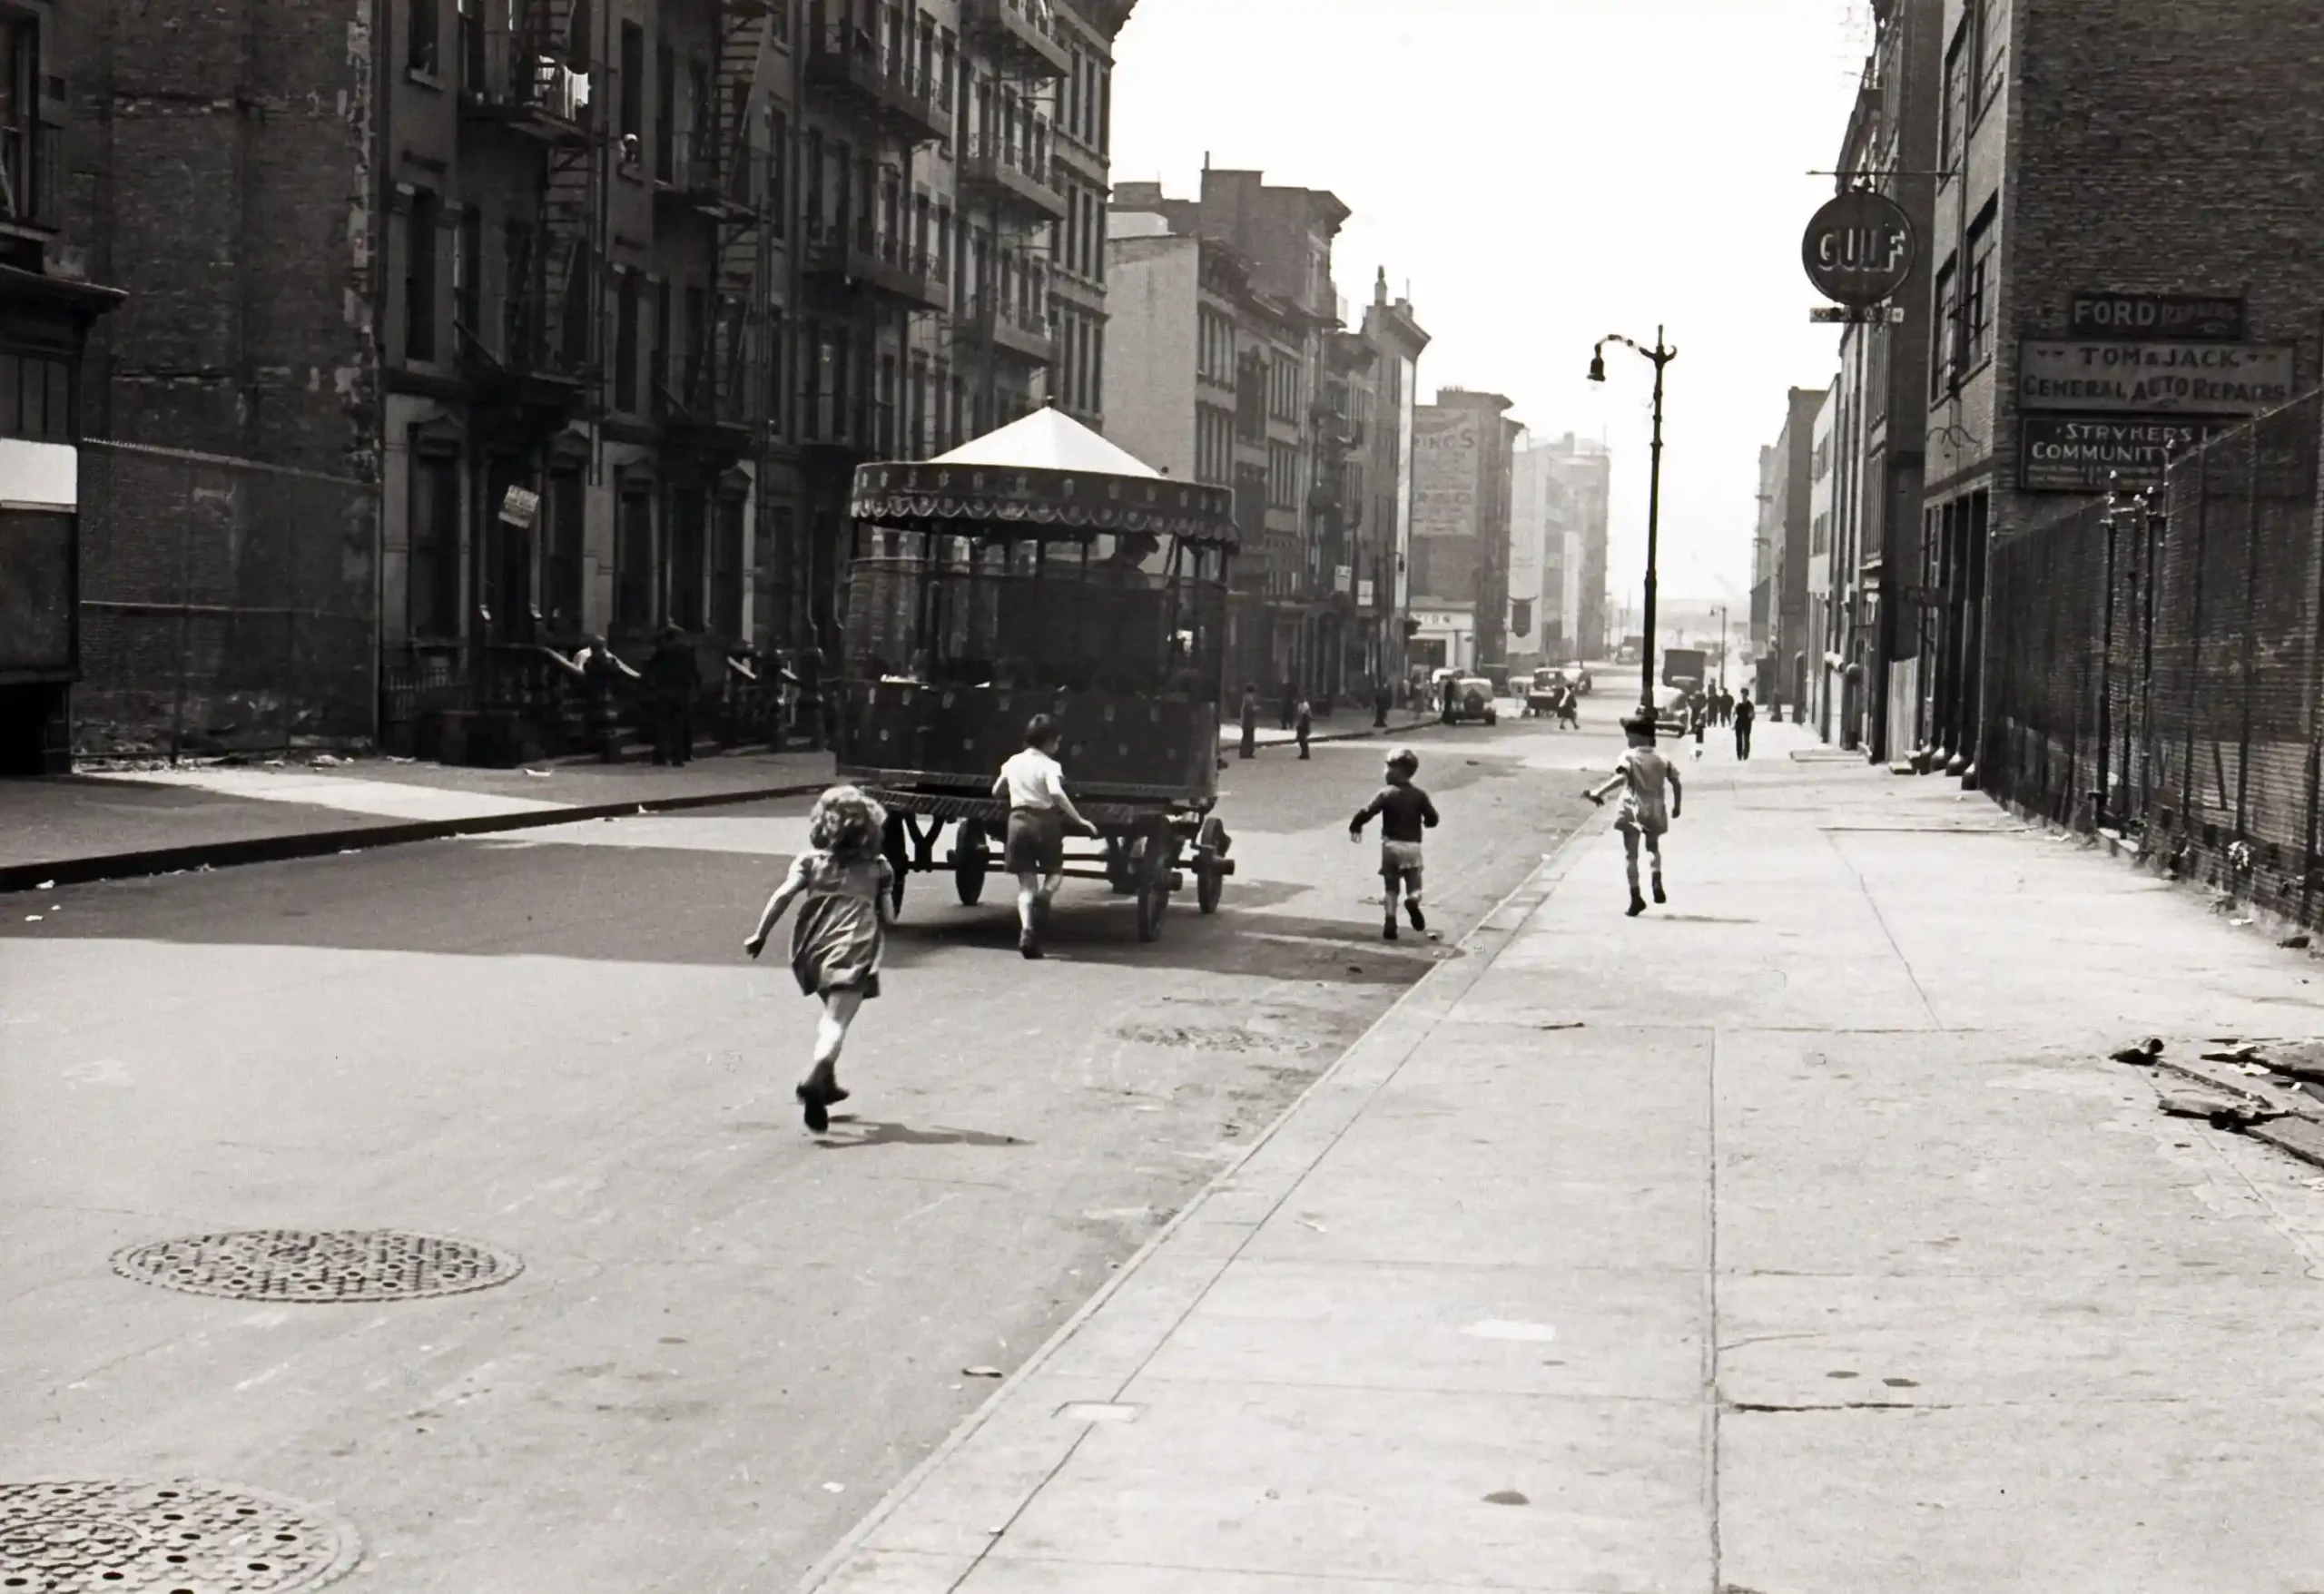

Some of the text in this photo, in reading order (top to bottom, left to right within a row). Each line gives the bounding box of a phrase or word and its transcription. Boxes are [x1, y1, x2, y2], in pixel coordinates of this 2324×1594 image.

[1818, 228, 1905, 272] GULF
[2074, 300, 2156, 326] FORD
[2078, 347, 2142, 367] TOM
[2161, 348, 2240, 369] JACK
[2192, 377, 2286, 402] REPAIRS
[2032, 440, 2171, 462] COMMUNITY
